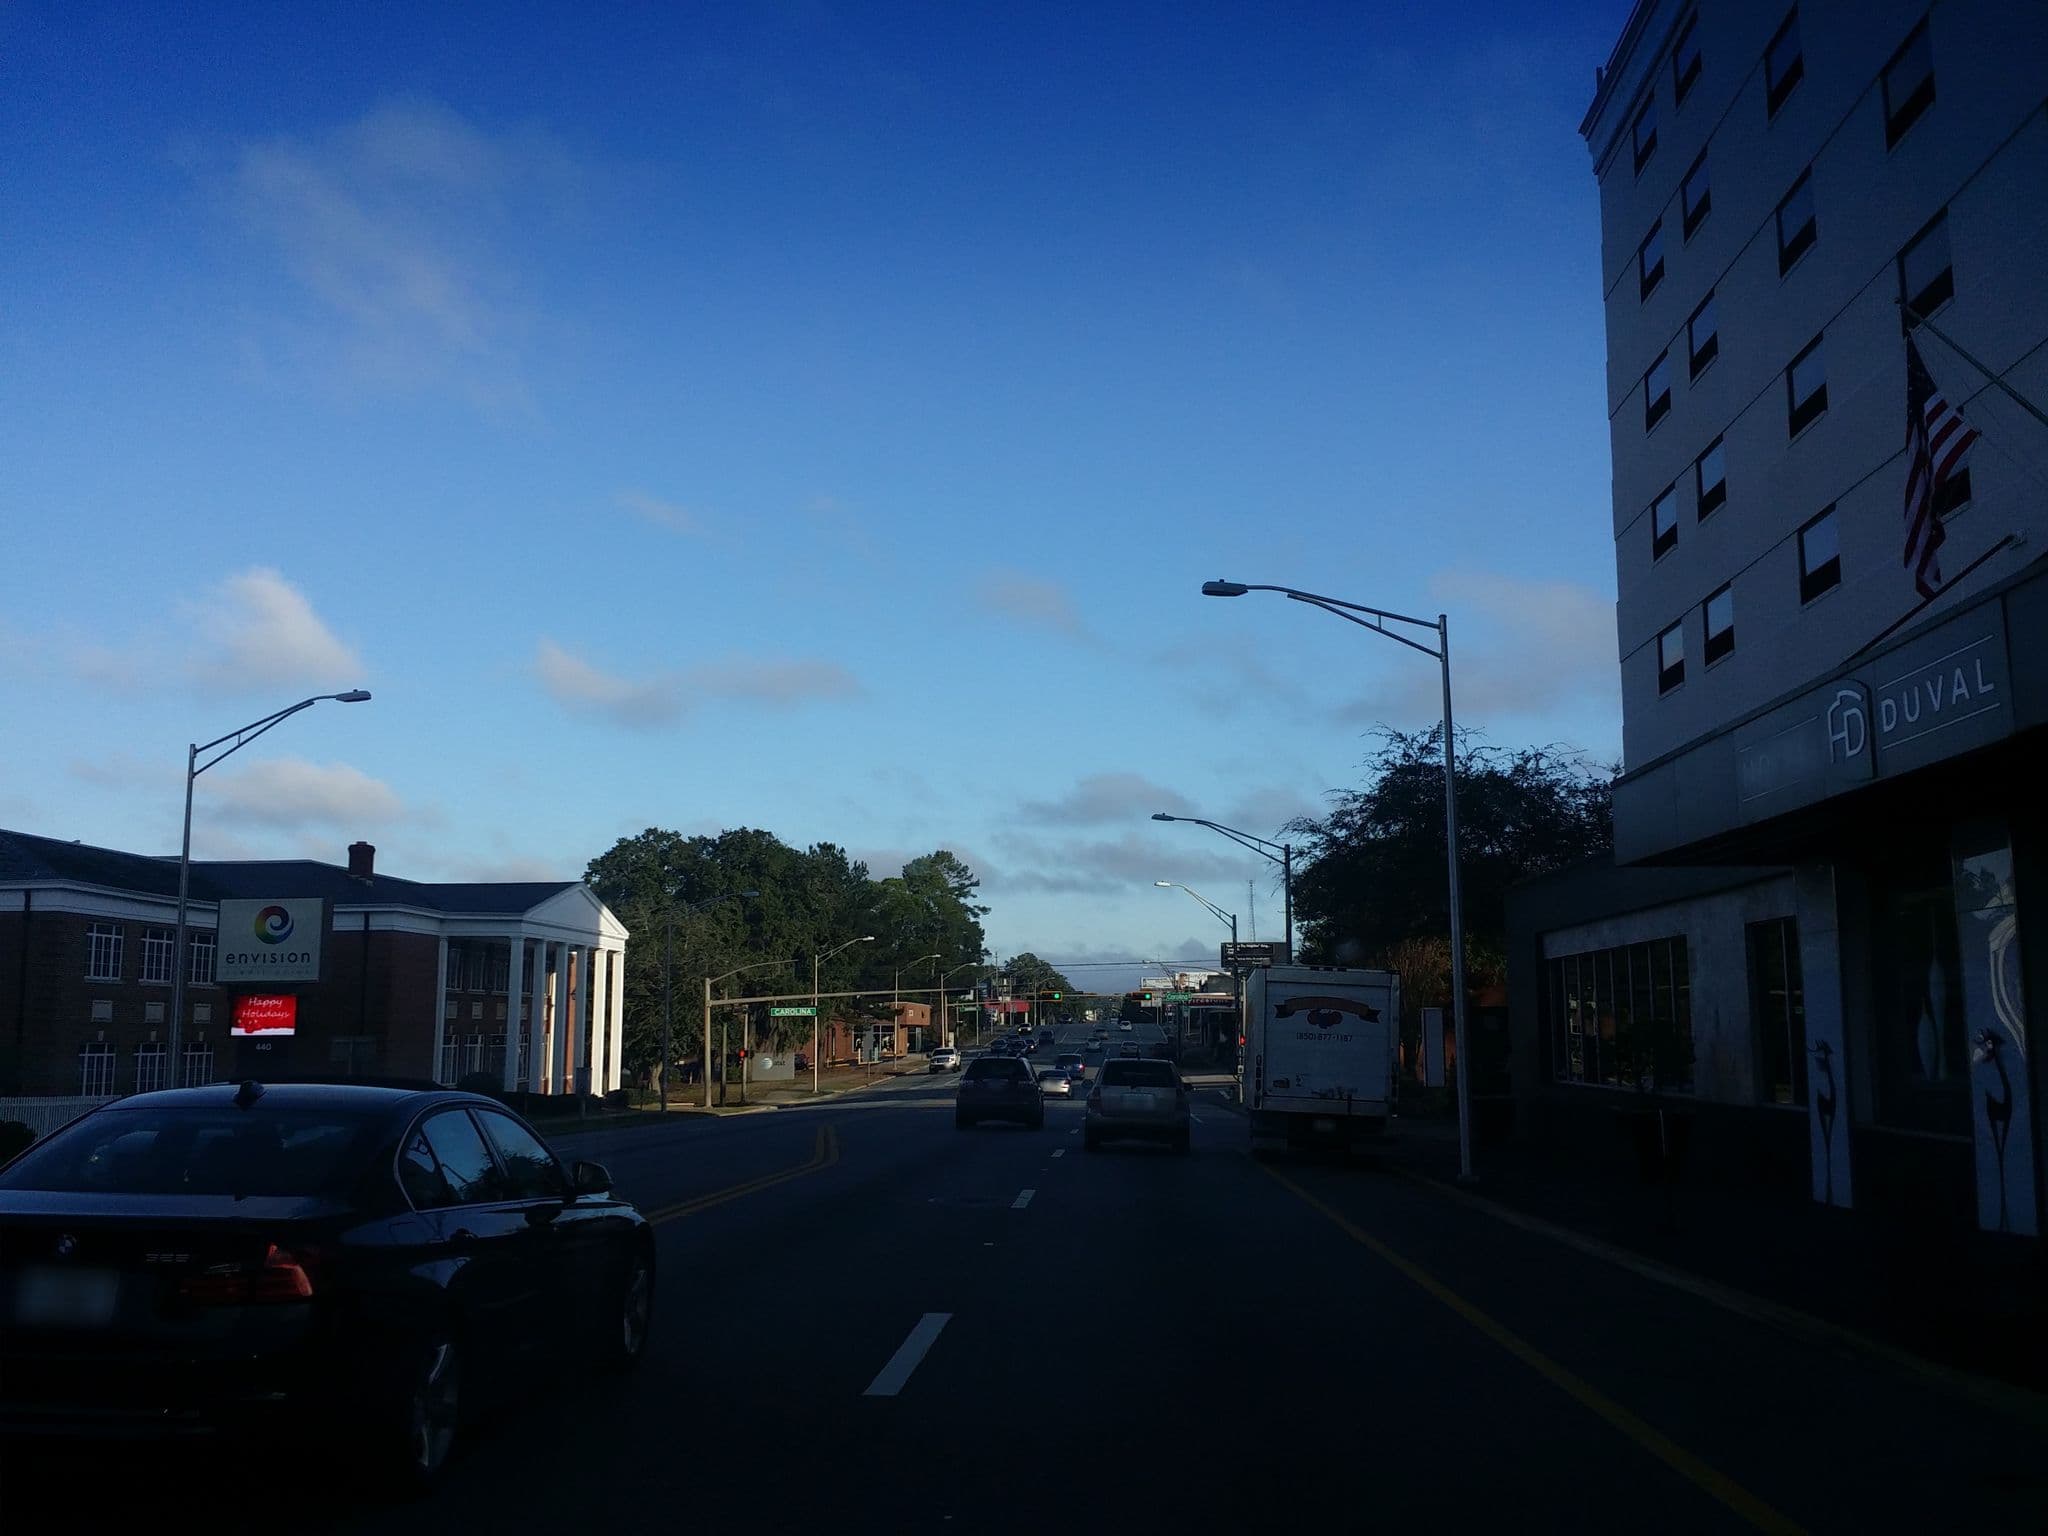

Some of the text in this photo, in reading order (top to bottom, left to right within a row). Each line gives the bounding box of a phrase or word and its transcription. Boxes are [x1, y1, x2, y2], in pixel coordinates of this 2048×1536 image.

[1880, 657, 1994, 733] DUVAL
[225, 952, 311, 964] envision
[248, 996, 283, 1008] Happy
[241, 1008, 290, 1019] Holidays
[774, 1008, 812, 1016] CAROLINA
[255, 1042, 272, 1051] 440
